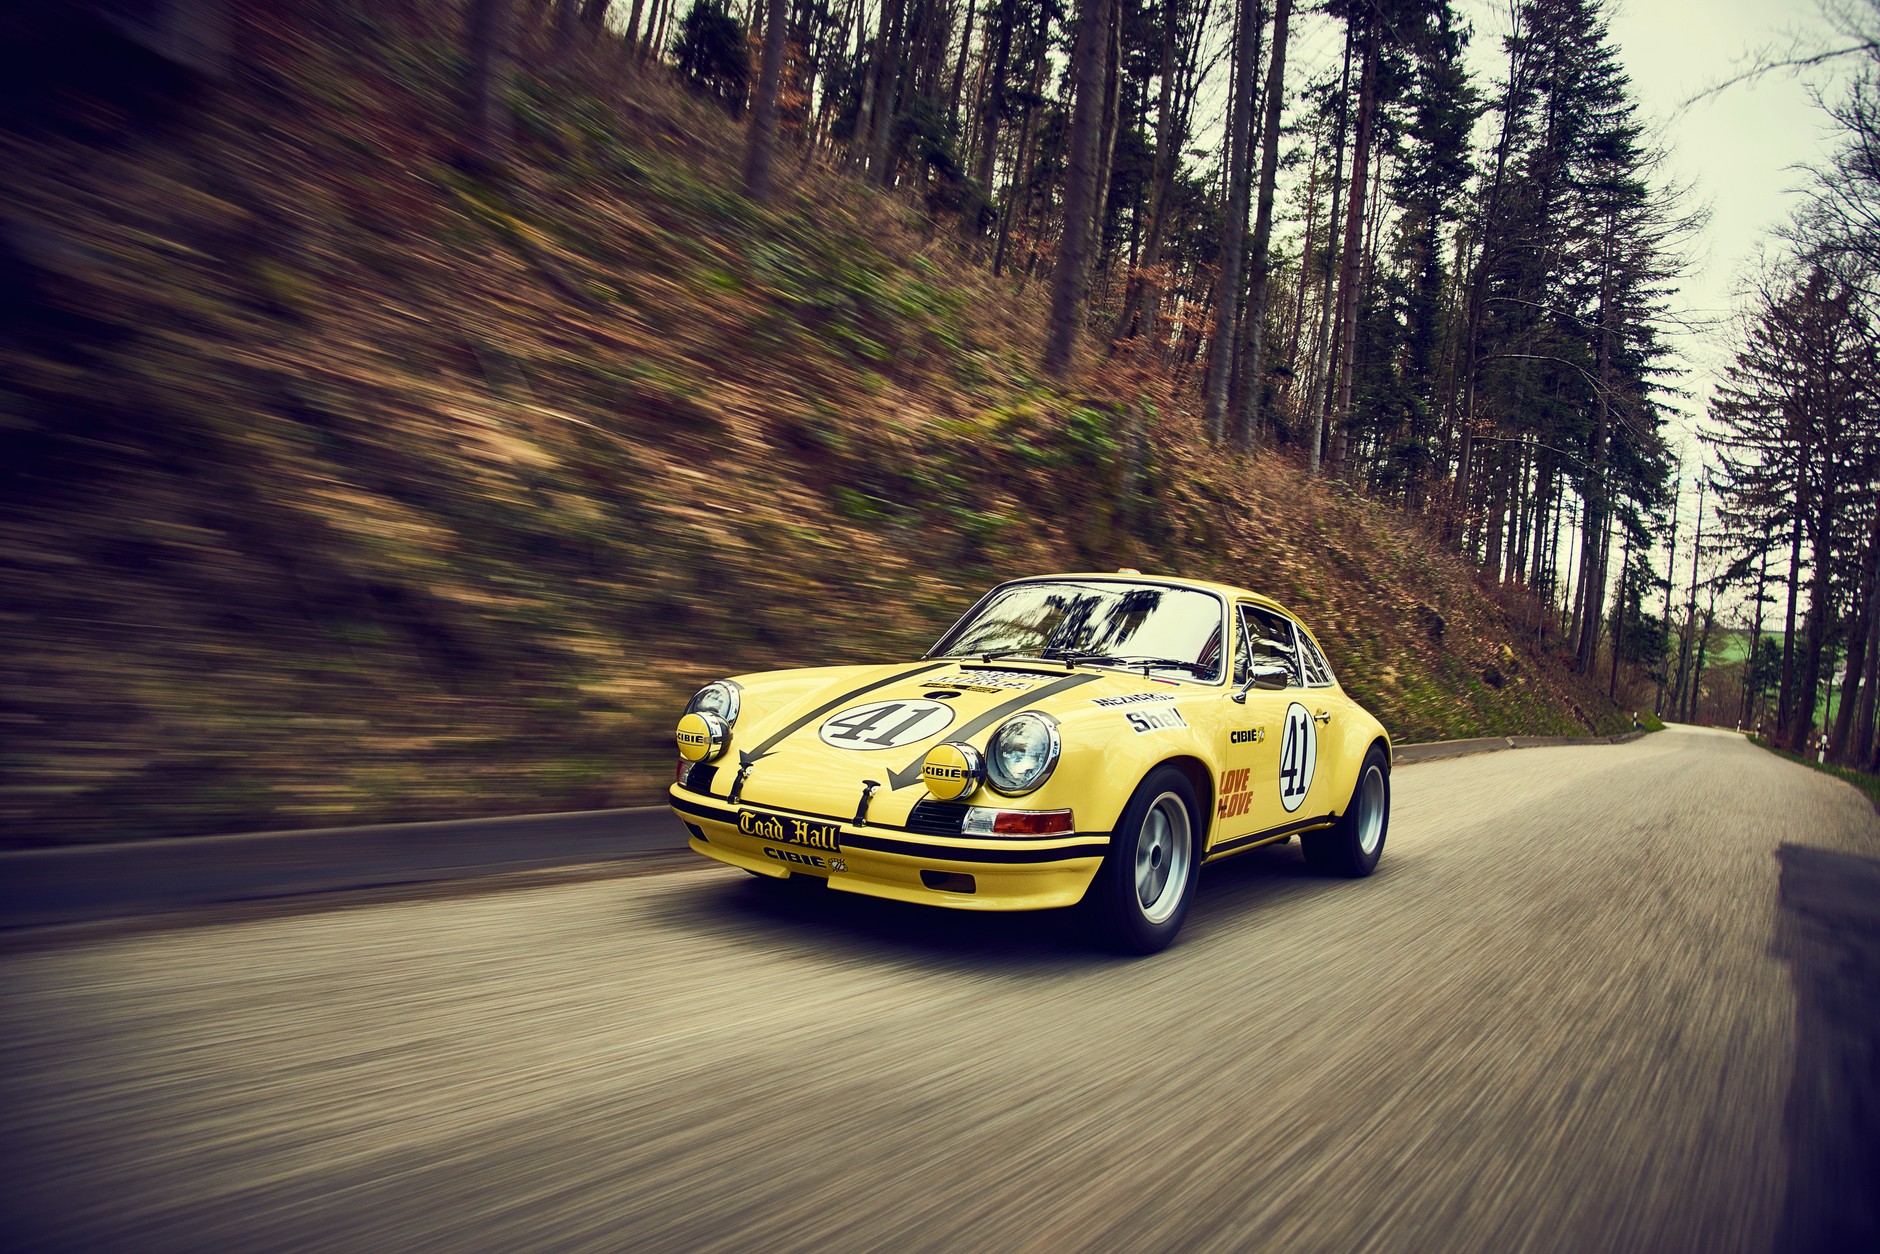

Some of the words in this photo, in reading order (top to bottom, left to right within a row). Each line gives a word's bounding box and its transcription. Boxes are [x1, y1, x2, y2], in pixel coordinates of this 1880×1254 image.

[828, 703, 941, 746] 41
[1126, 707, 1187, 732] Shell
[1280, 713, 1308, 797] 41
[1219, 768, 1250, 795] LOVE
[740, 811, 784, 840] Toad
[789, 819, 837, 850] Hall
